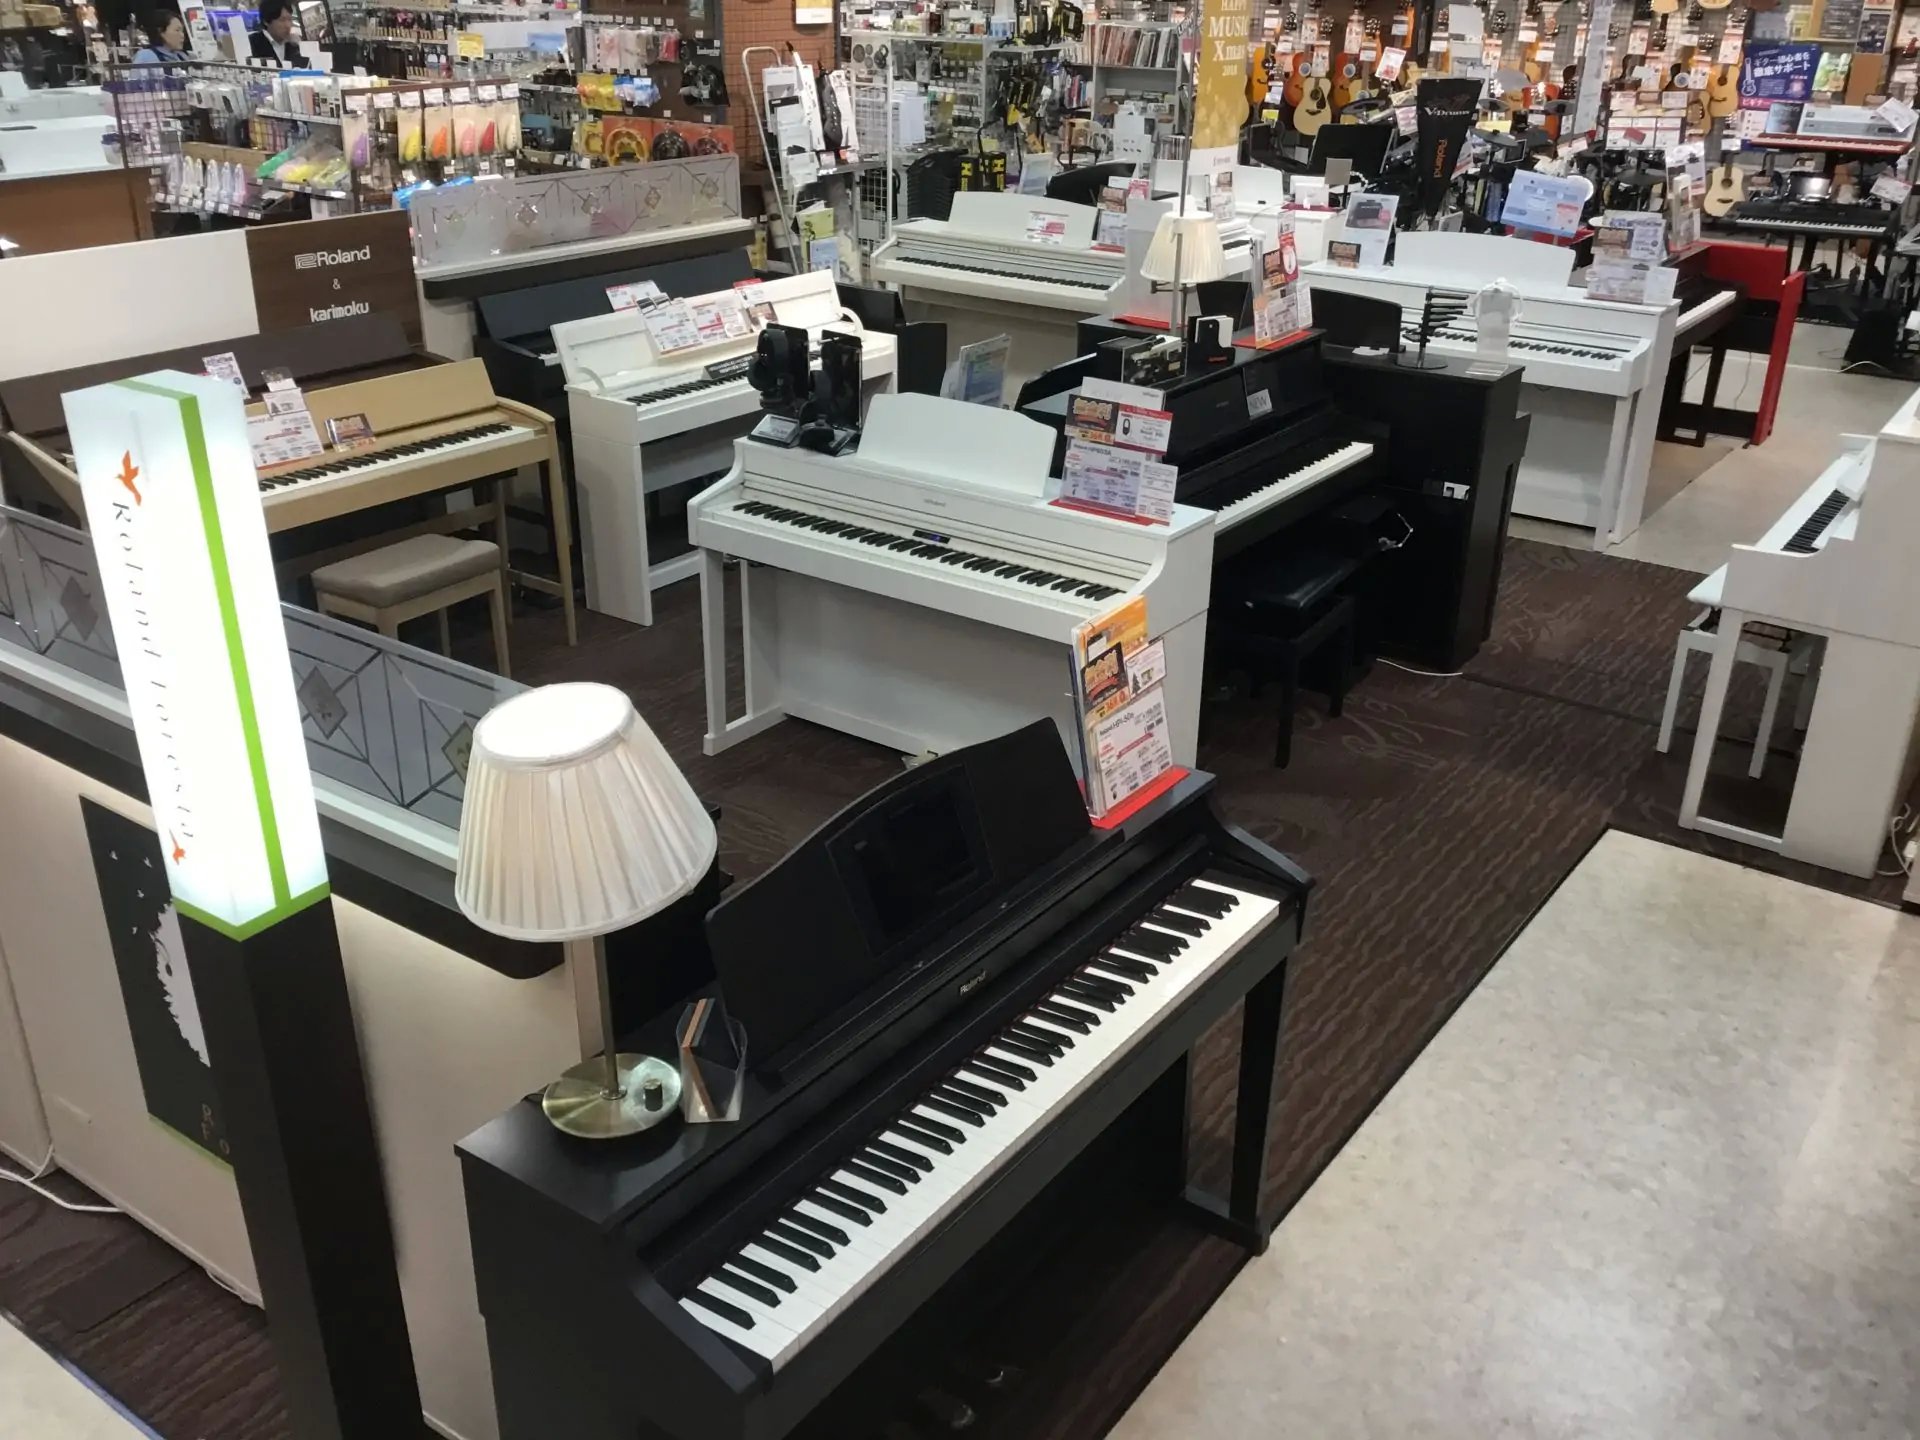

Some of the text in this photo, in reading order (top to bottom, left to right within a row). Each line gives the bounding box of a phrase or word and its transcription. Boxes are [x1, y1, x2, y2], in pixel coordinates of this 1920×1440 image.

[1432, 139, 1448, 178] Roland
[316, 244, 371, 267] Roland
[332, 278, 341, 290] &
[309, 301, 370, 323] karimoku
[111, 502, 163, 658] Roland
